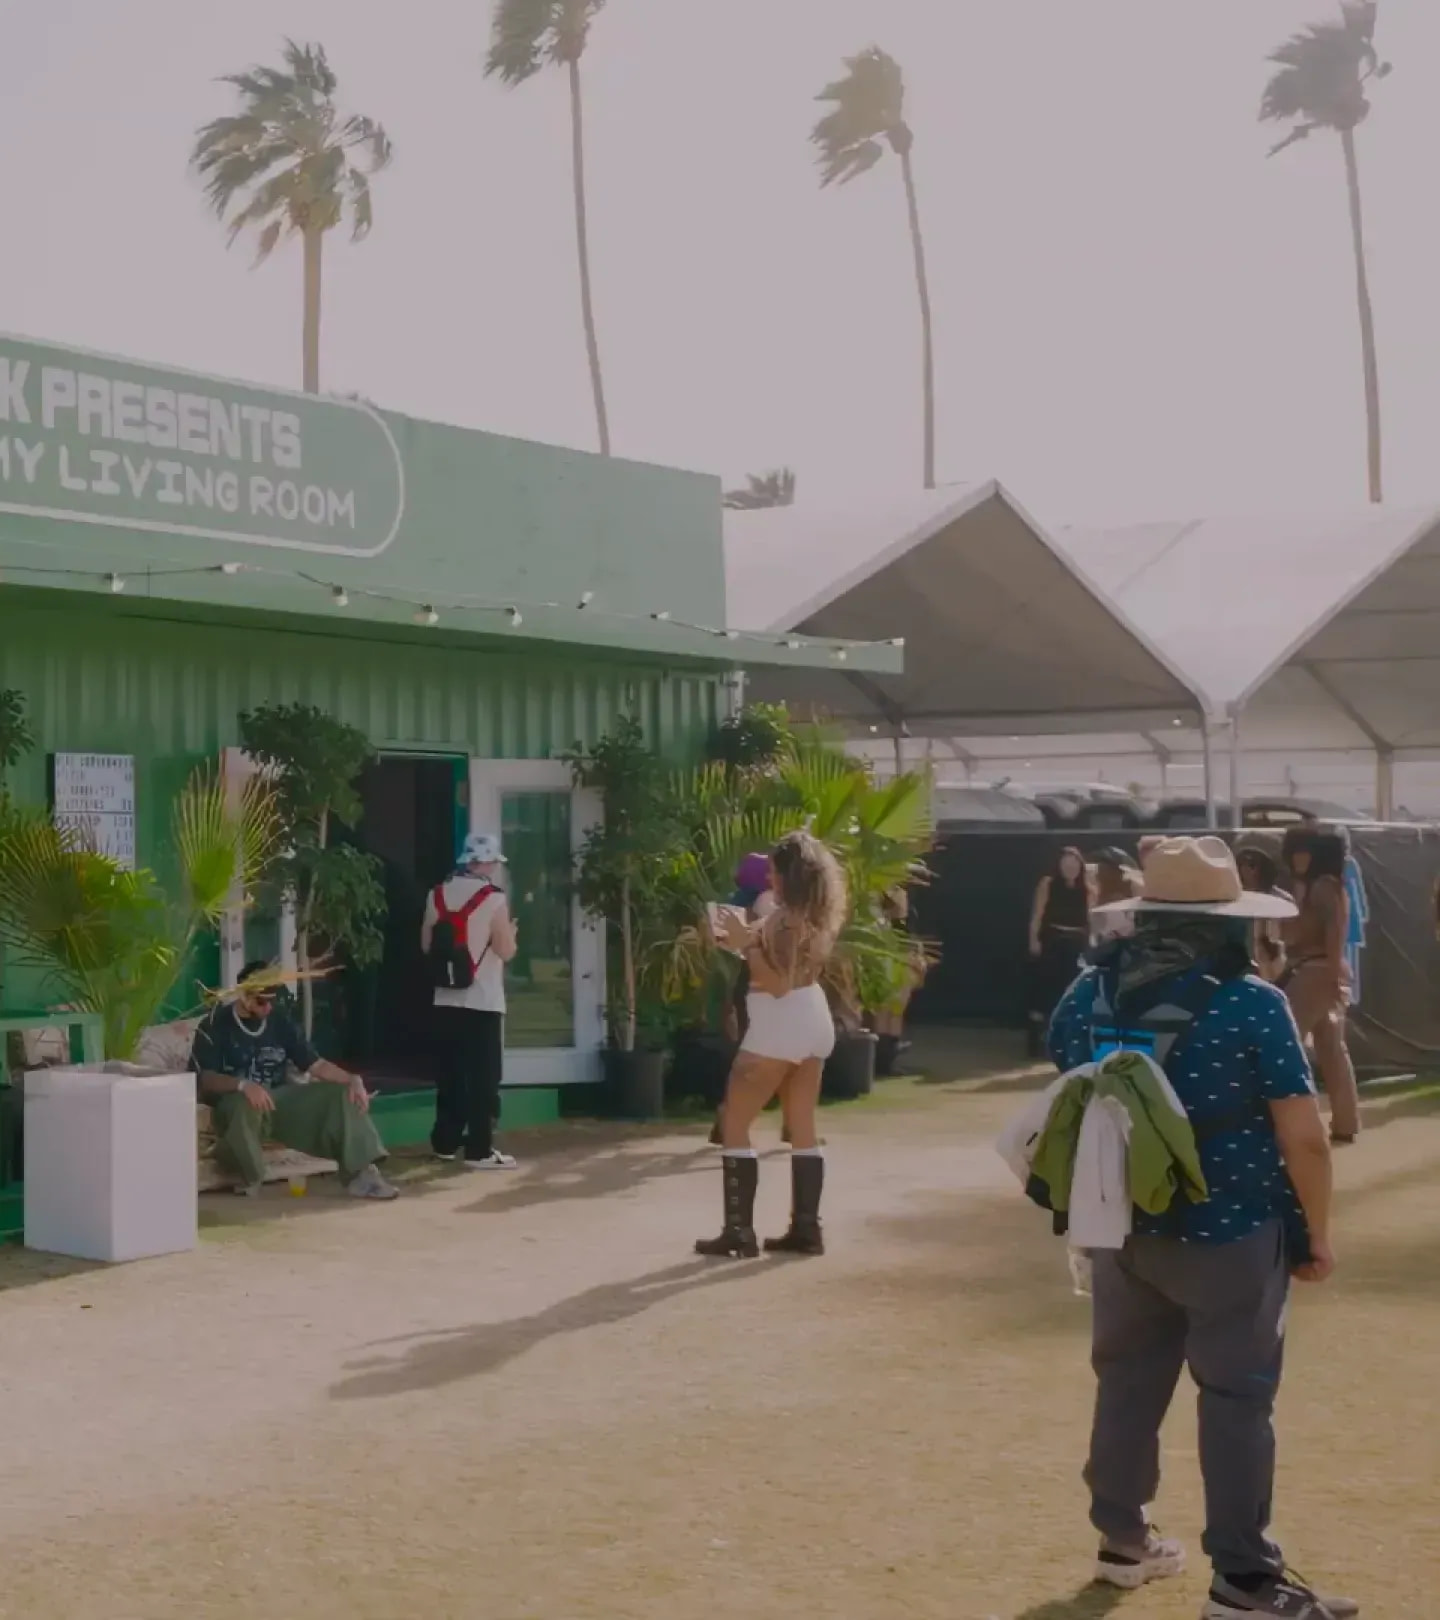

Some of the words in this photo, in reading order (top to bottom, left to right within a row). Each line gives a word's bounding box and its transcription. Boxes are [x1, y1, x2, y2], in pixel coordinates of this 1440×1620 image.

[41, 368, 301, 469] PRESENTS
[58, 445, 239, 513] LIVING
[249, 475, 357, 529] ROOM
